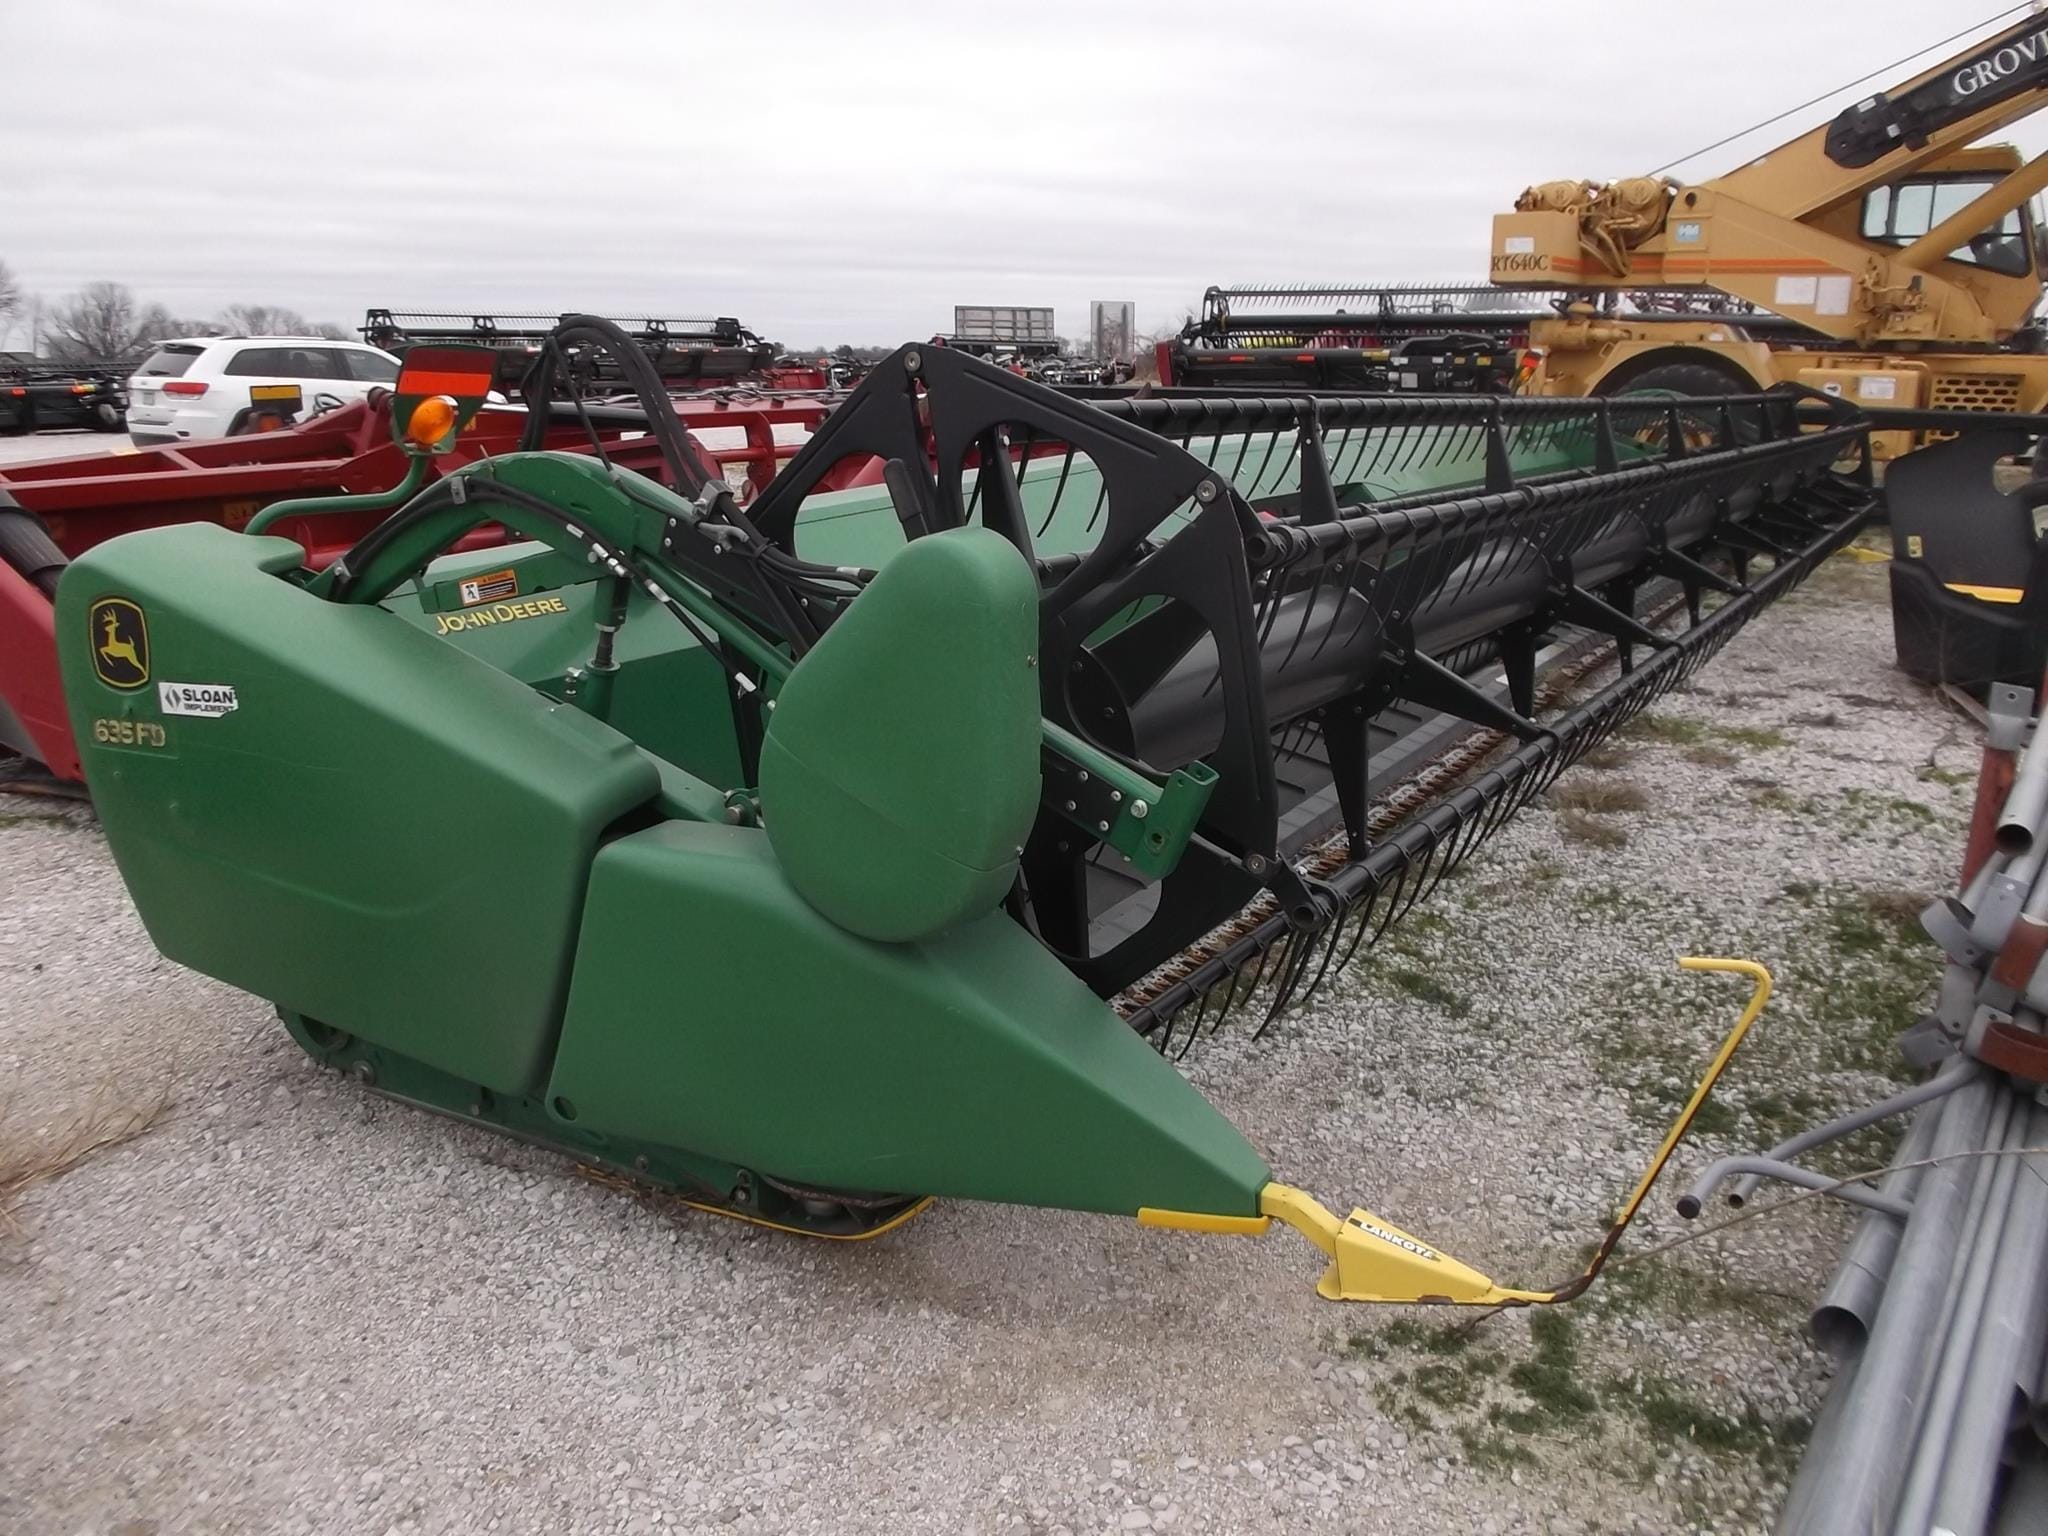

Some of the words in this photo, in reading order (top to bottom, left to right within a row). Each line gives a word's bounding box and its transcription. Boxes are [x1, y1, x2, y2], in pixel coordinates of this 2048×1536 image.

[1492, 253, 1548, 272] RT640C
[437, 611, 497, 636] JOHN
[493, 597, 567, 622] DEERE
[182, 688, 233, 704] SLOAN
[95, 718, 166, 747] 635FD
